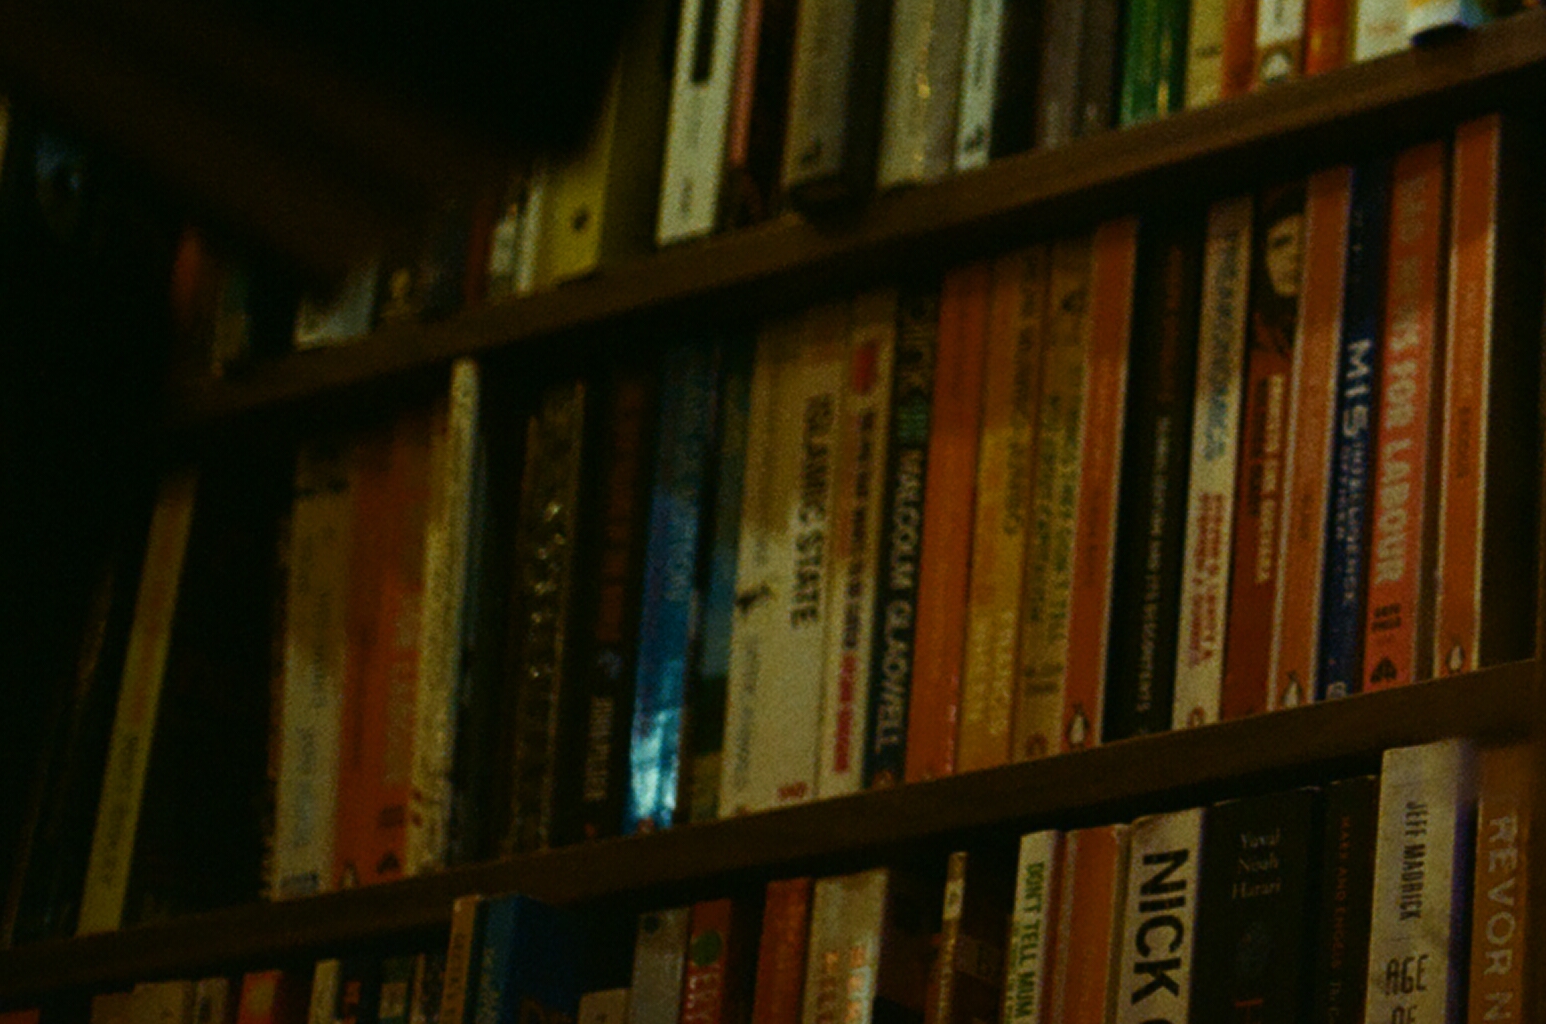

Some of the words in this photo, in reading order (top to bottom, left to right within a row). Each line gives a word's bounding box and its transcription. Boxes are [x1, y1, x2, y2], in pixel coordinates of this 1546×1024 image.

[1383, 360, 1418, 429] FOR
[799, 392, 834, 522] ISLAMIC
[887, 447, 924, 590] MALCOLM
[1254, 498, 1278, 585] GUEVARA
[1374, 437, 1413, 585] LABOUR
[789, 524, 823, 630] STATE
[873, 596, 914, 755] GLADWELL
[988, 610, 1016, 737] FRANCIS
[1239, 827, 1283, 850] Yuval
[1404, 800, 1428, 837] JEFF
[1230, 879, 1283, 902] Harari
[1237, 855, 1280, 877] Noah
[1399, 842, 1427, 922] MADRICK
[1482, 807, 1519, 976] REVOR
[1018, 919, 1044, 971] TELL
[1131, 848, 1190, 1006] NICK
[1014, 971, 1037, 1020] MUM
[1384, 952, 1430, 996] AGE
